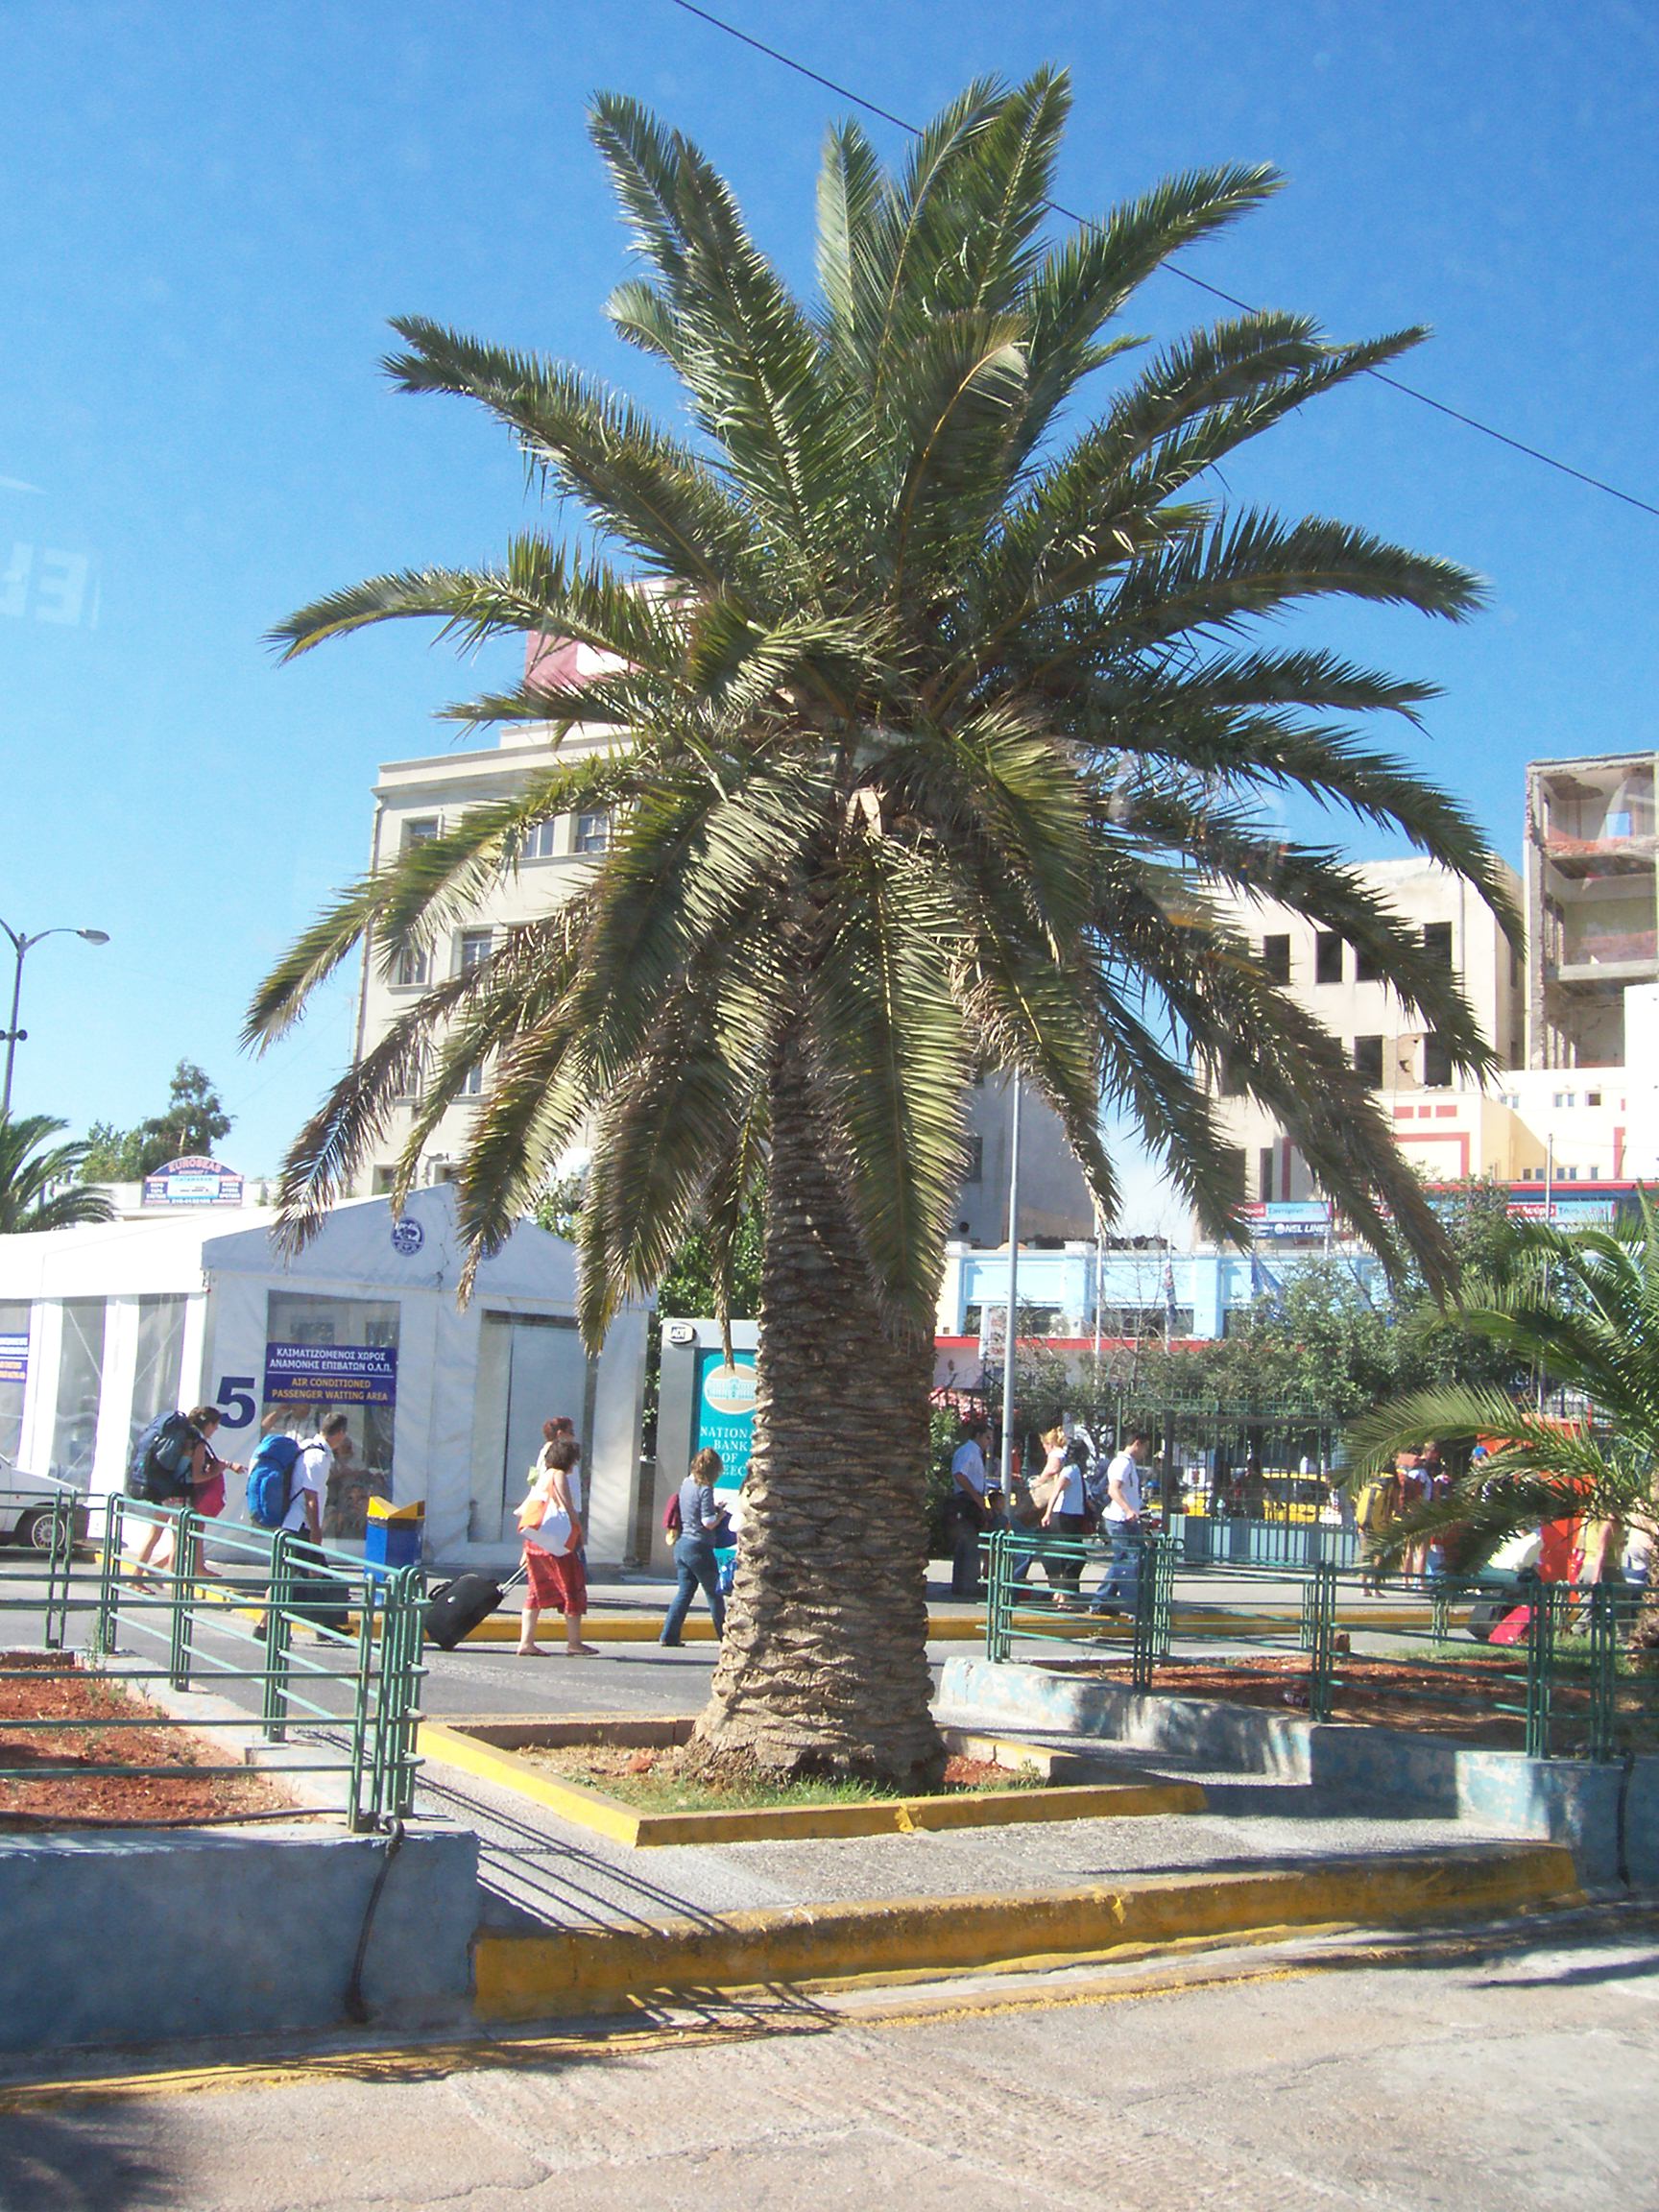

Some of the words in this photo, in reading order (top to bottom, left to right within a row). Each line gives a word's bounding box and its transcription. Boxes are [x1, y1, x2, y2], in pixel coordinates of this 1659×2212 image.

[276, 1347, 356, 1360] ΚΛΙΜΑΤΙΖΟΜΕΝΟΣ
[357, 1352, 386, 1361] ΧΩΡΟΣ
[269, 1358, 320, 1369] ΑΝΑΜΟΝΗΣ
[322, 1360, 366, 1371] ΕΠΙΒΑΤΩΝ
[291, 1377, 308, 1387] AIR
[309, 1379, 372, 1389] CONDITIONED
[272, 1388, 324, 1399] PASSENGER
[325, 1390, 365, 1400] WAITING
[366, 1391, 388, 1401] AREA
[216, 1377, 256, 1429] 5
[700, 1426, 752, 1439] NATION
[713, 1439, 748, 1452] BANK
[721, 1453, 738, 1463] OF
